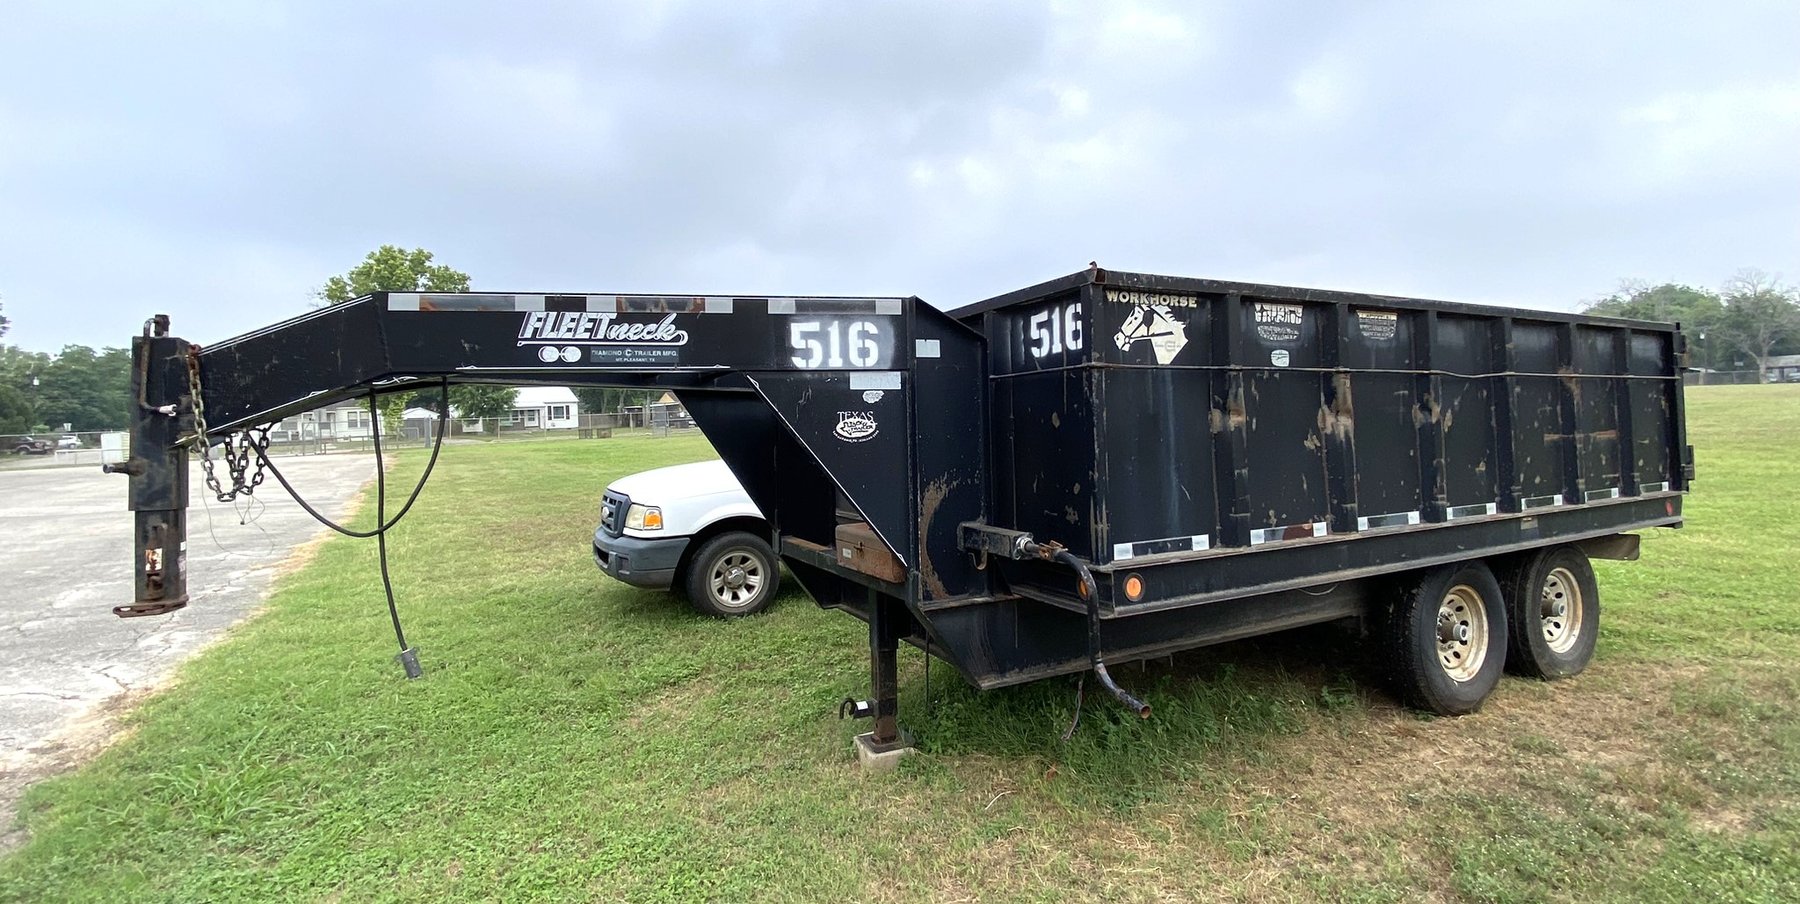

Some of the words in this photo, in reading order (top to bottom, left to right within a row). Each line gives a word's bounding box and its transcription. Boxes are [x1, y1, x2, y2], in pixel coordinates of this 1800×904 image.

[1105, 290, 1198, 308] WORKHORSE
[790, 320, 879, 368] 516
[1030, 302, 1083, 358] 516
[837, 411, 874, 422] TEXAS
